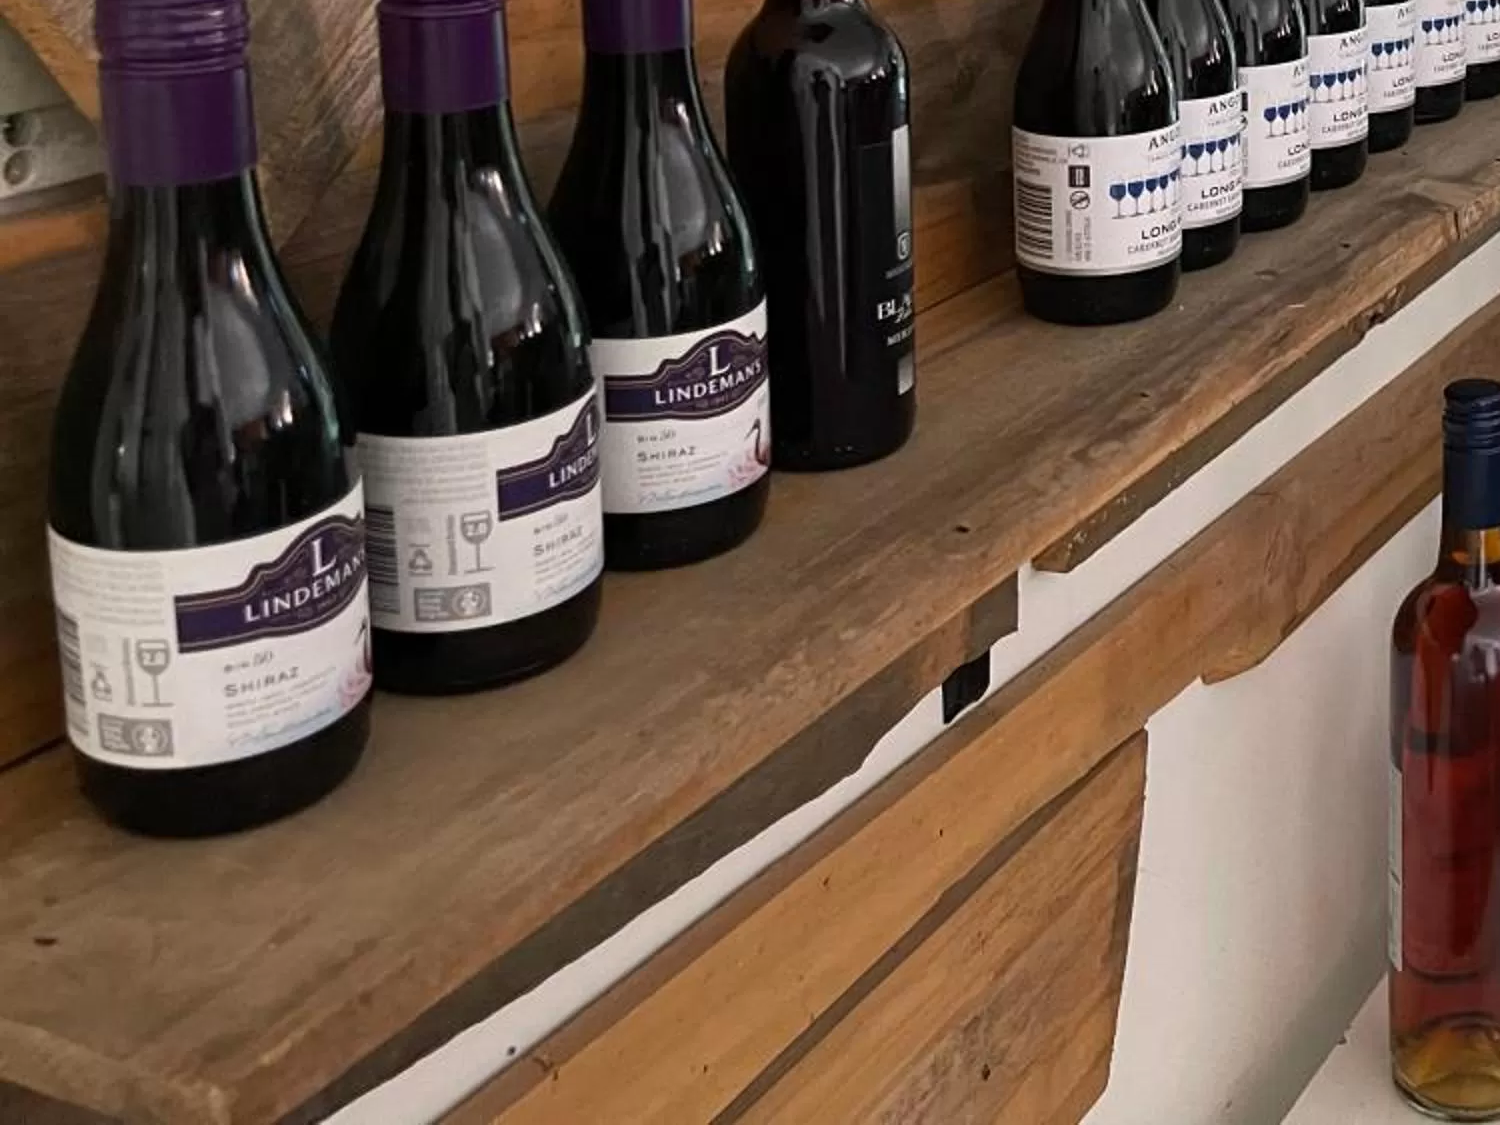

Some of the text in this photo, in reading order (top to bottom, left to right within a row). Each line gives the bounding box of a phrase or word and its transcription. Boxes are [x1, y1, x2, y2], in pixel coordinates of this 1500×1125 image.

[708, 346, 733, 376] L
[636, 445, 696, 463] SHIRAZ
[533, 525, 583, 556] SHIRAZ
[311, 537, 337, 577] L
[224, 666, 300, 698] SHIRAZ
